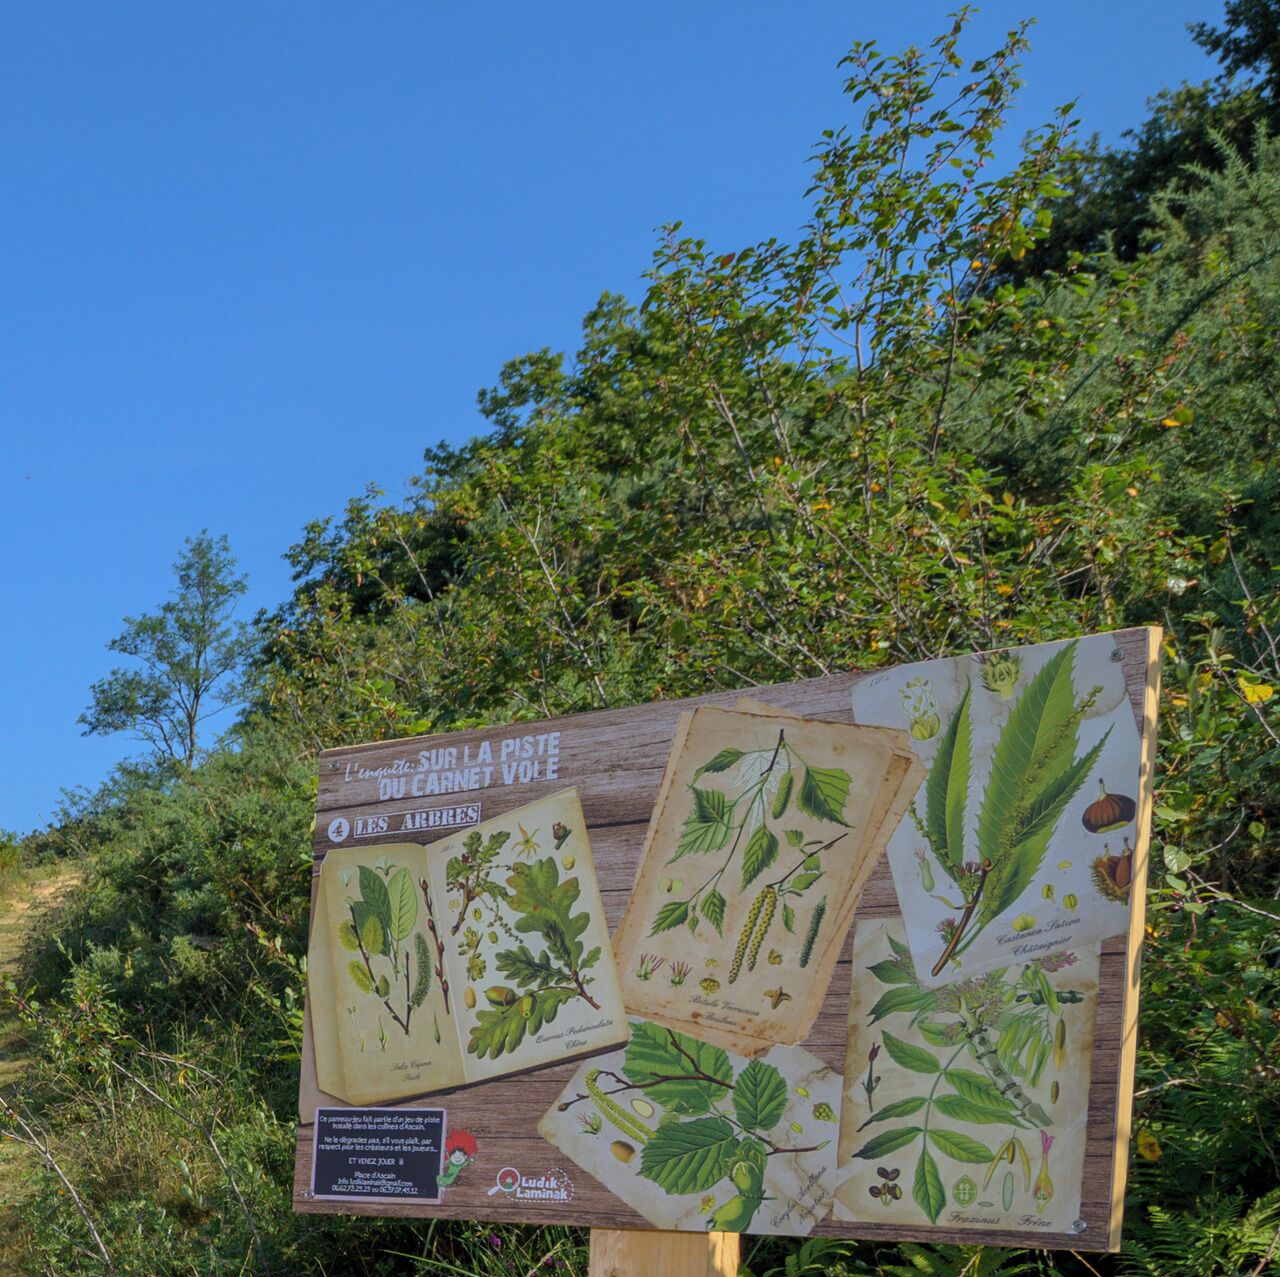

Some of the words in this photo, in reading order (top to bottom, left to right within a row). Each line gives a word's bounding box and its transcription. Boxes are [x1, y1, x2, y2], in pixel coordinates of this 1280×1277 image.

[418, 747, 458, 772] SUR
[463, 741, 493, 767] LA
[501, 731, 561, 761] PISTE
[380, 777, 406, 801] DU
[411, 765, 494, 797] CARNET
[356, 816, 389, 835] LES
[401, 805, 479, 830] ARBRES
[333, 821, 345, 838] 4
[324, 1136, 333, 1144] Ne
[377, 1158, 396, 1166] JOUER
[522, 1177, 561, 1189] Ludik
[516, 1187, 568, 1200] Laminak
